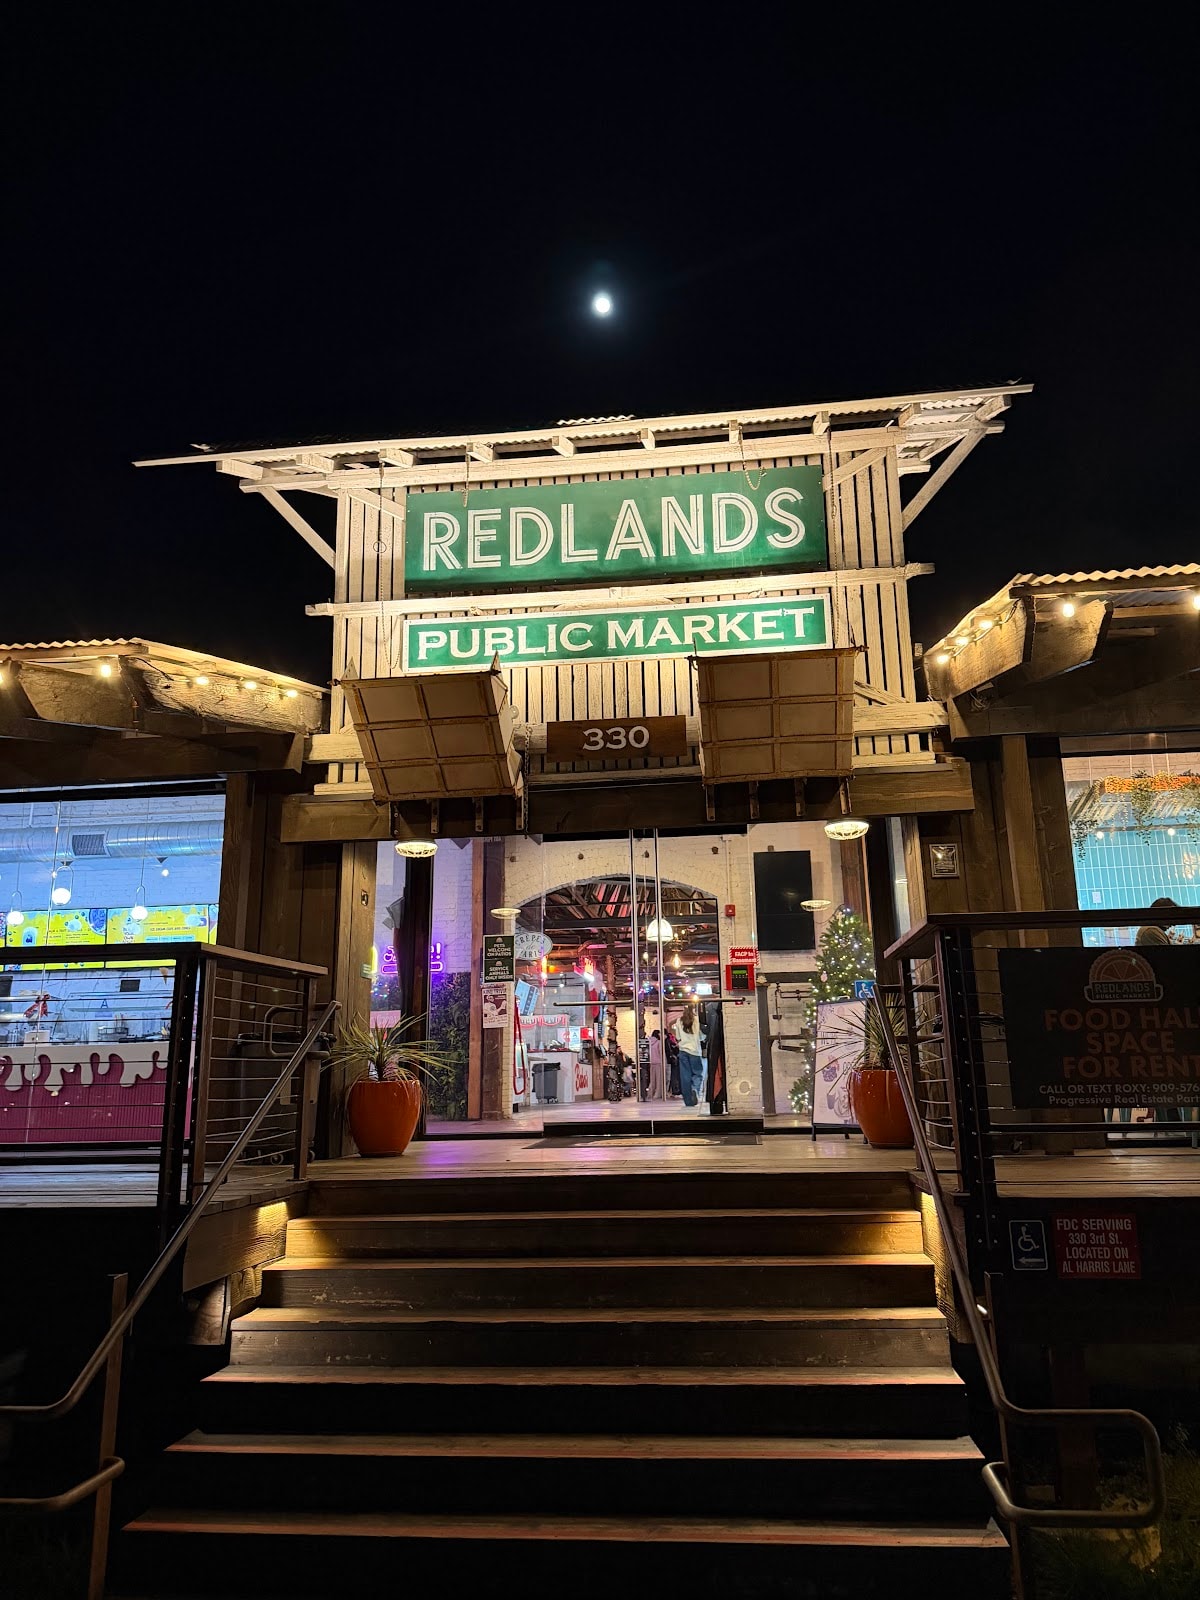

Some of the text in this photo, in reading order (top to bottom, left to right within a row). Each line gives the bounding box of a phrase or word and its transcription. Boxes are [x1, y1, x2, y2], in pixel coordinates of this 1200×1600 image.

[422, 486, 807, 571] REDLANDS
[416, 606, 815, 660] PUBLIC MARKET
[582, 725, 650, 752] 330
[1094, 982, 1150, 993] REDLANDS
[1043, 1007, 1200, 1030] FOOD HAL
[1086, 1031, 1175, 1054] SPACE
[1062, 1055, 1200, 1078] FOR RENT
[1039, 1085, 1065, 1094] CALL
[1067, 1085, 1086, 1094] OR
[1087, 1084, 1113, 1094] TEXT
[1115, 1083, 1151, 1094] ROXY:
[1049, 1095, 1111, 1106] Progressive
[1114, 1094, 1138, 1104] Real
[1141, 1094, 1174, 1104] Estate
[1056, 1218, 1132, 1231] FDC SERVING
[1068, 1232, 1123, 1245] 330 3rd St.
[1065, 1247, 1129, 1259] LOCATED ON
[1062, 1261, 1136, 1273] AL HARRIS LANE
